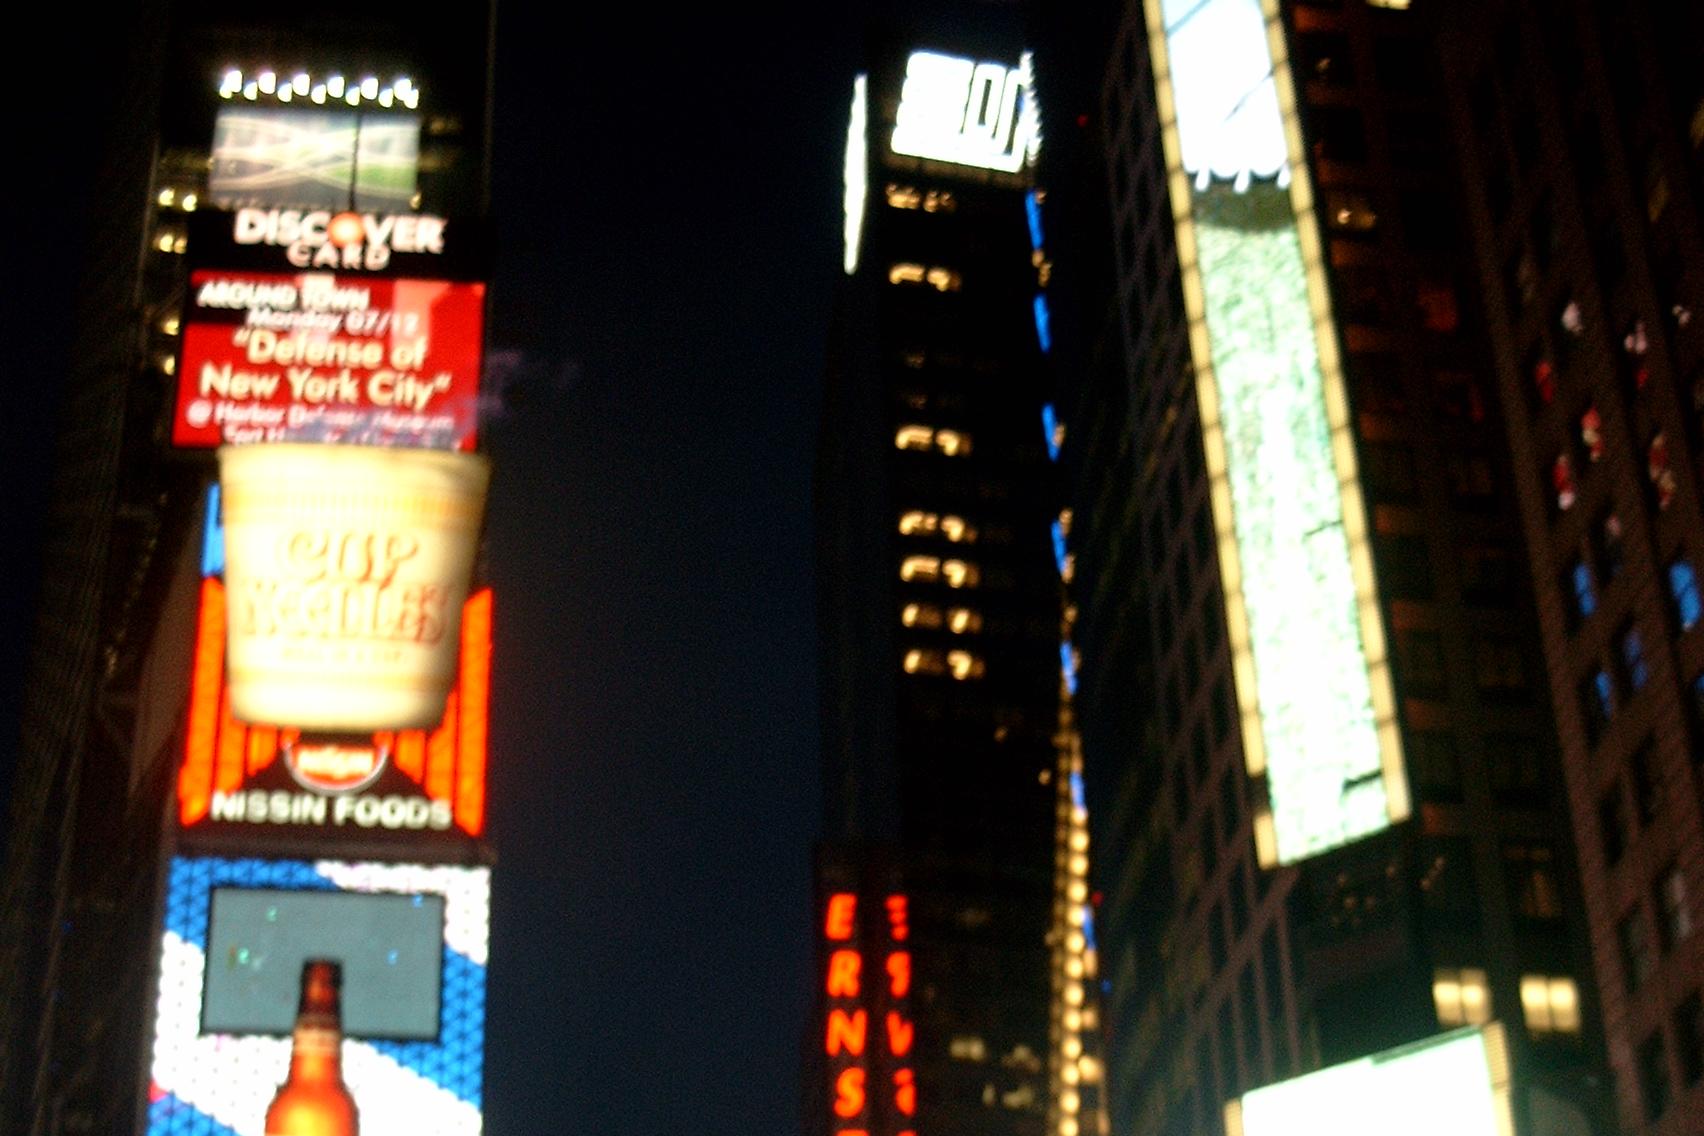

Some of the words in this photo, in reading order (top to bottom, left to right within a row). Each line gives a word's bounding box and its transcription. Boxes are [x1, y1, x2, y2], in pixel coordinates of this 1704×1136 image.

[233, 207, 449, 254] DISCOVER
[286, 241, 392, 271] CARD
[390, 335, 430, 372] of
[199, 362, 280, 402] New
[287, 366, 361, 403] York
[210, 789, 326, 825] NISSIN
[334, 795, 452, 831] FOODS
